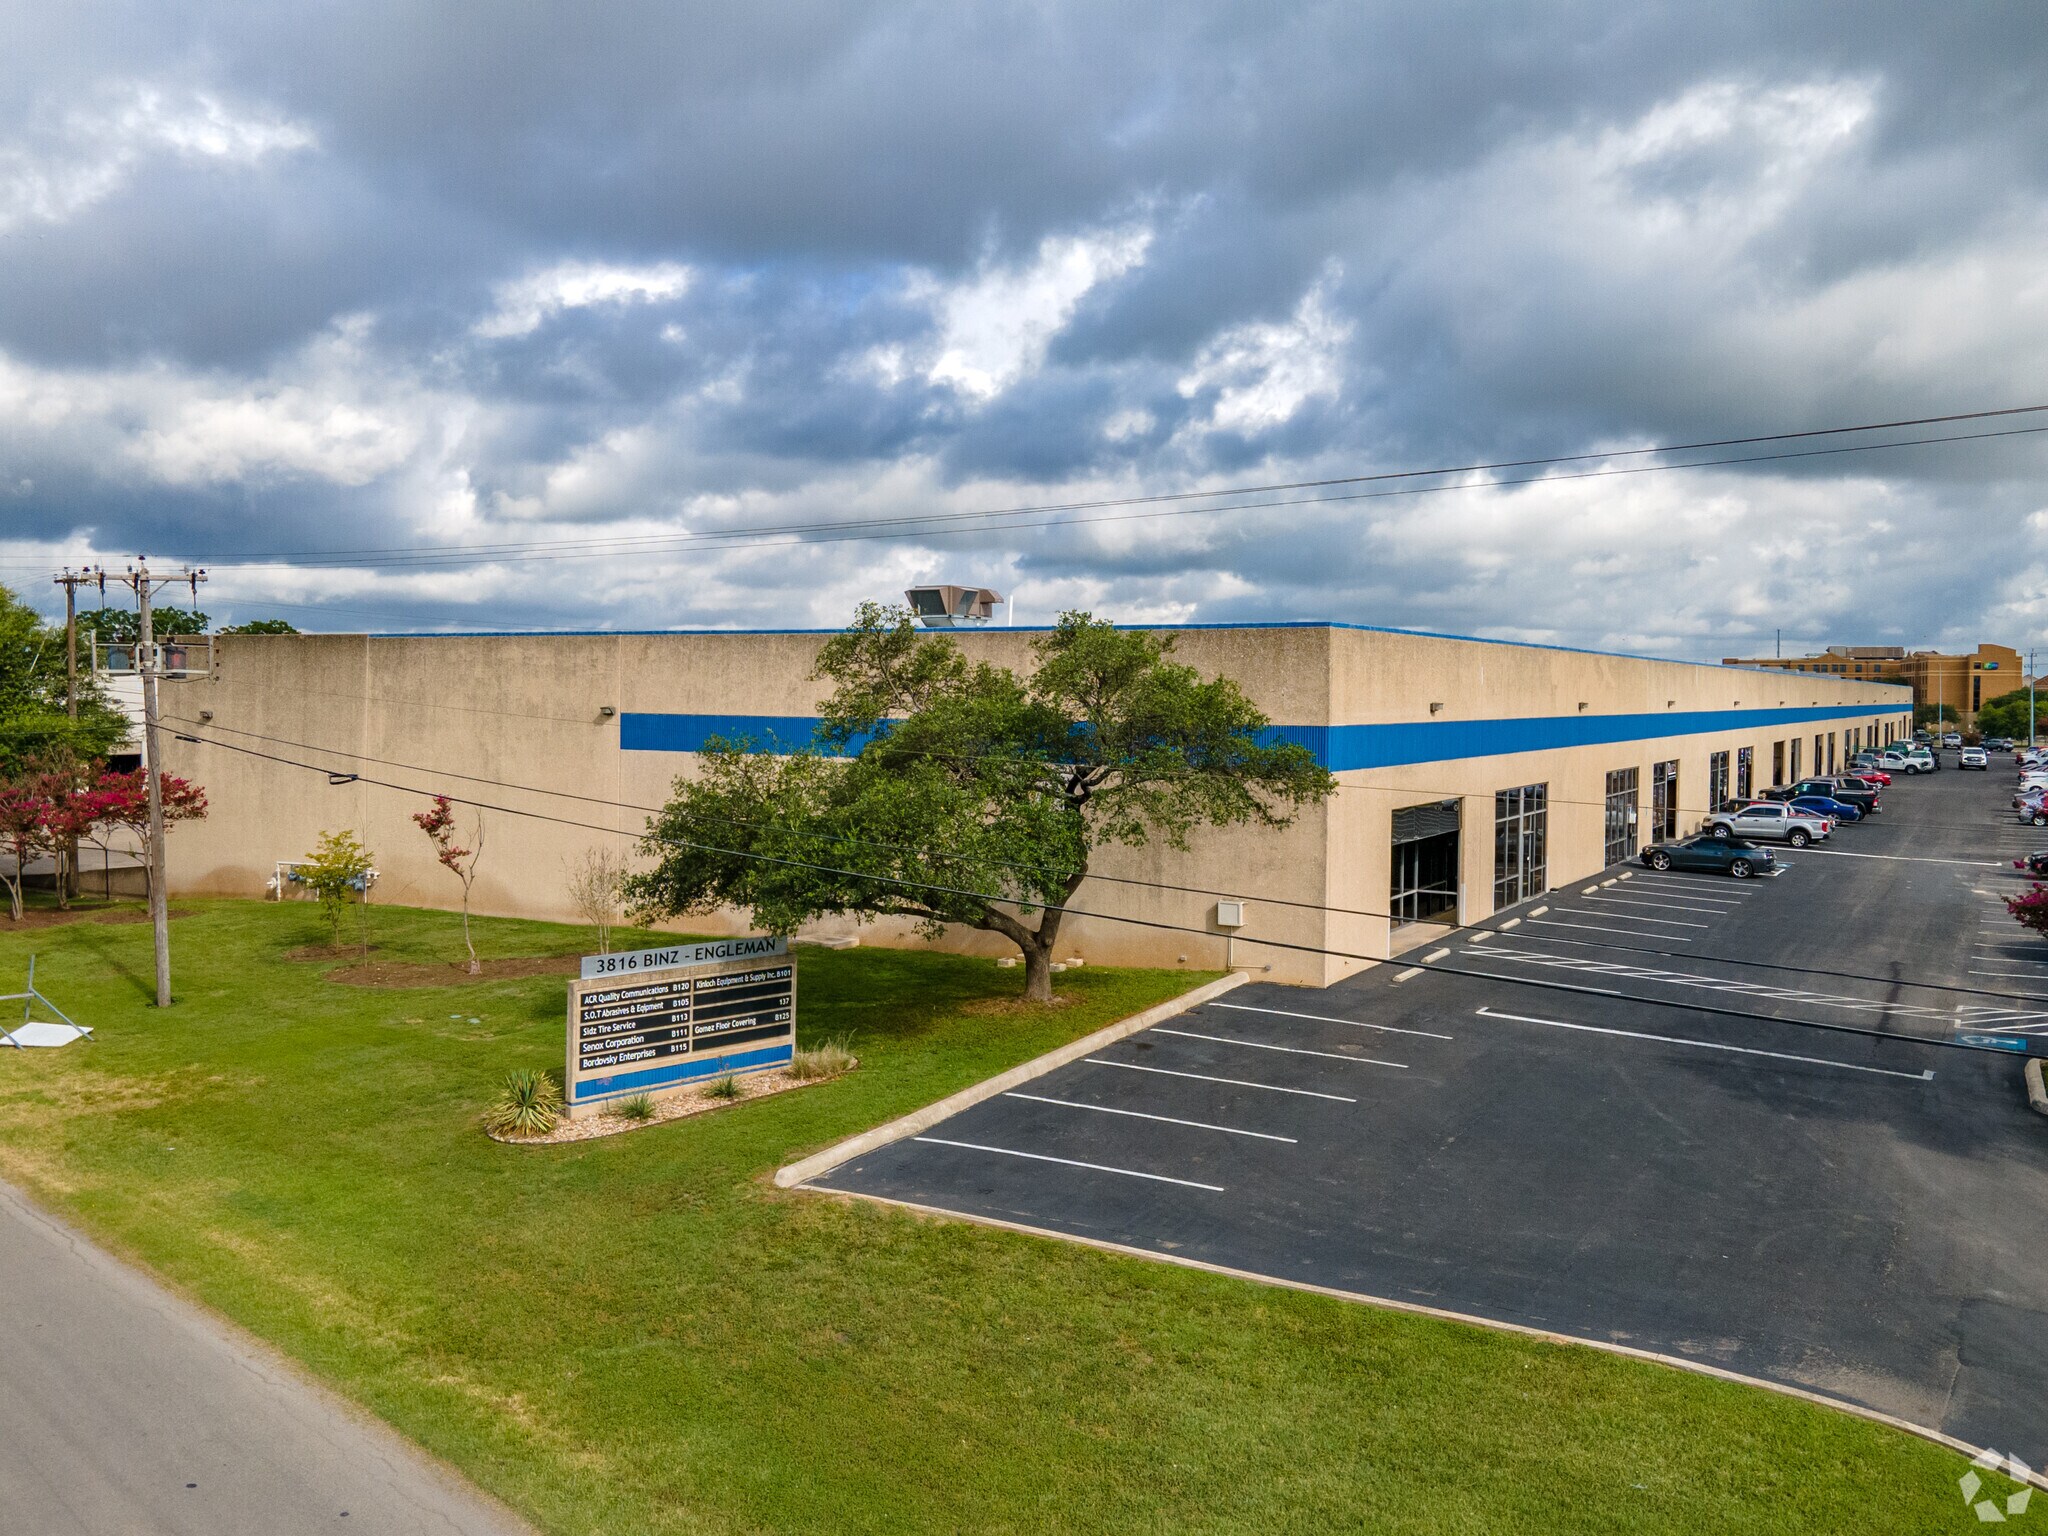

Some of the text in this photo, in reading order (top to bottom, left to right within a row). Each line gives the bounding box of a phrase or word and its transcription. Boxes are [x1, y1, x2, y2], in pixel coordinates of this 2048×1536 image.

[596, 955, 637, 973] 3816
[643, 951, 679, 967] BINZ
[695, 939, 776, 961] ENGLEMAN
[716, 976, 744, 987] Equipment
[750, 973, 766, 982] Supply
[584, 983, 690, 1004] ACR Quality Communications B120
[602, 1006, 630, 1018] Abrasives
[630, 1005, 636, 1013] &
[597, 1025, 612, 1034] Tire
[612, 1021, 637, 1032] Service
[671, 1013, 688, 1022] B113
[694, 1024, 715, 1034] Gomez
[715, 1020, 731, 1031] Floor
[731, 1017, 757, 1028] Covering
[582, 1042, 604, 1053] Senox
[605, 1035, 645, 1049] Corporation
[582, 1043, 687, 1069] Bordovsky Enterprises B115
